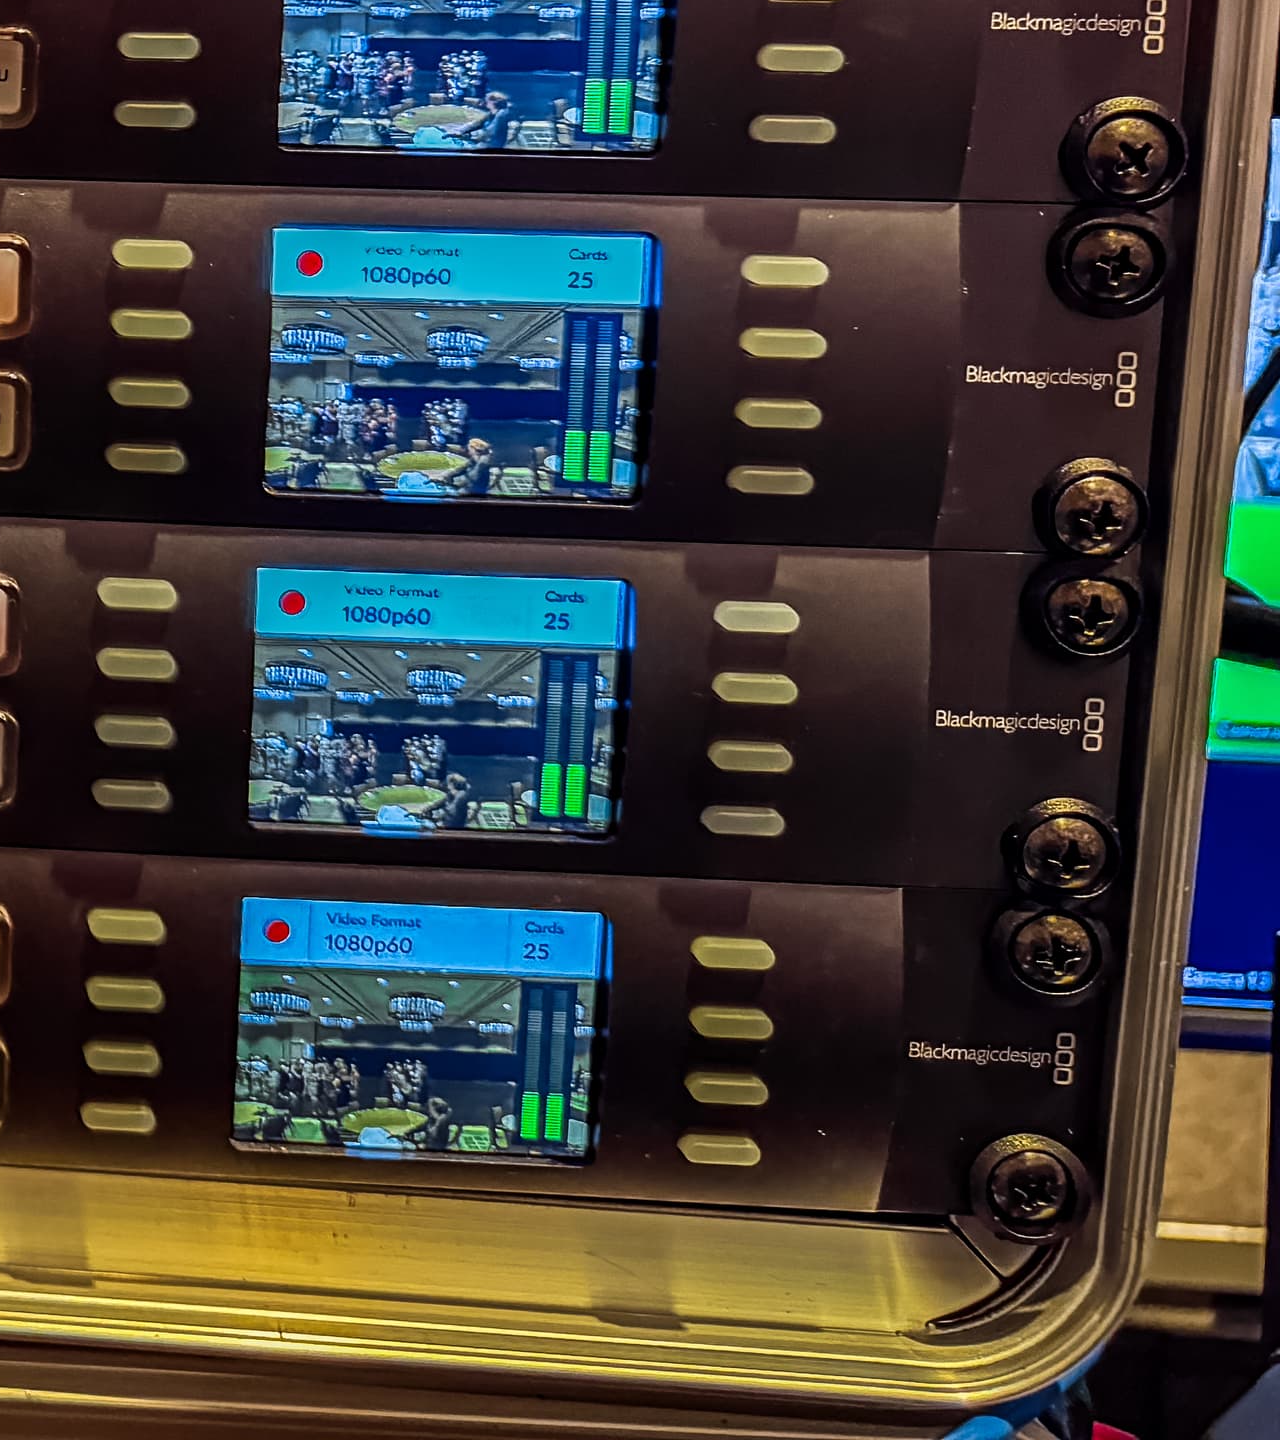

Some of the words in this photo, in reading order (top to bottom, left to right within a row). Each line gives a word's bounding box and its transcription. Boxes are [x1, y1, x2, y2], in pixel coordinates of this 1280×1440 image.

[568, 248, 609, 261] Cards
[362, 267, 450, 287] 1080p60
[567, 271, 594, 289] 25
[544, 590, 586, 604] Cards
[343, 606, 431, 627] 1080p60
[544, 613, 569, 630] 25
[326, 911, 368, 926] Video
[371, 913, 422, 929] Format
[524, 921, 565, 935] Cards
[325, 934, 412, 956] 1080p60
[523, 942, 550, 960] 25
